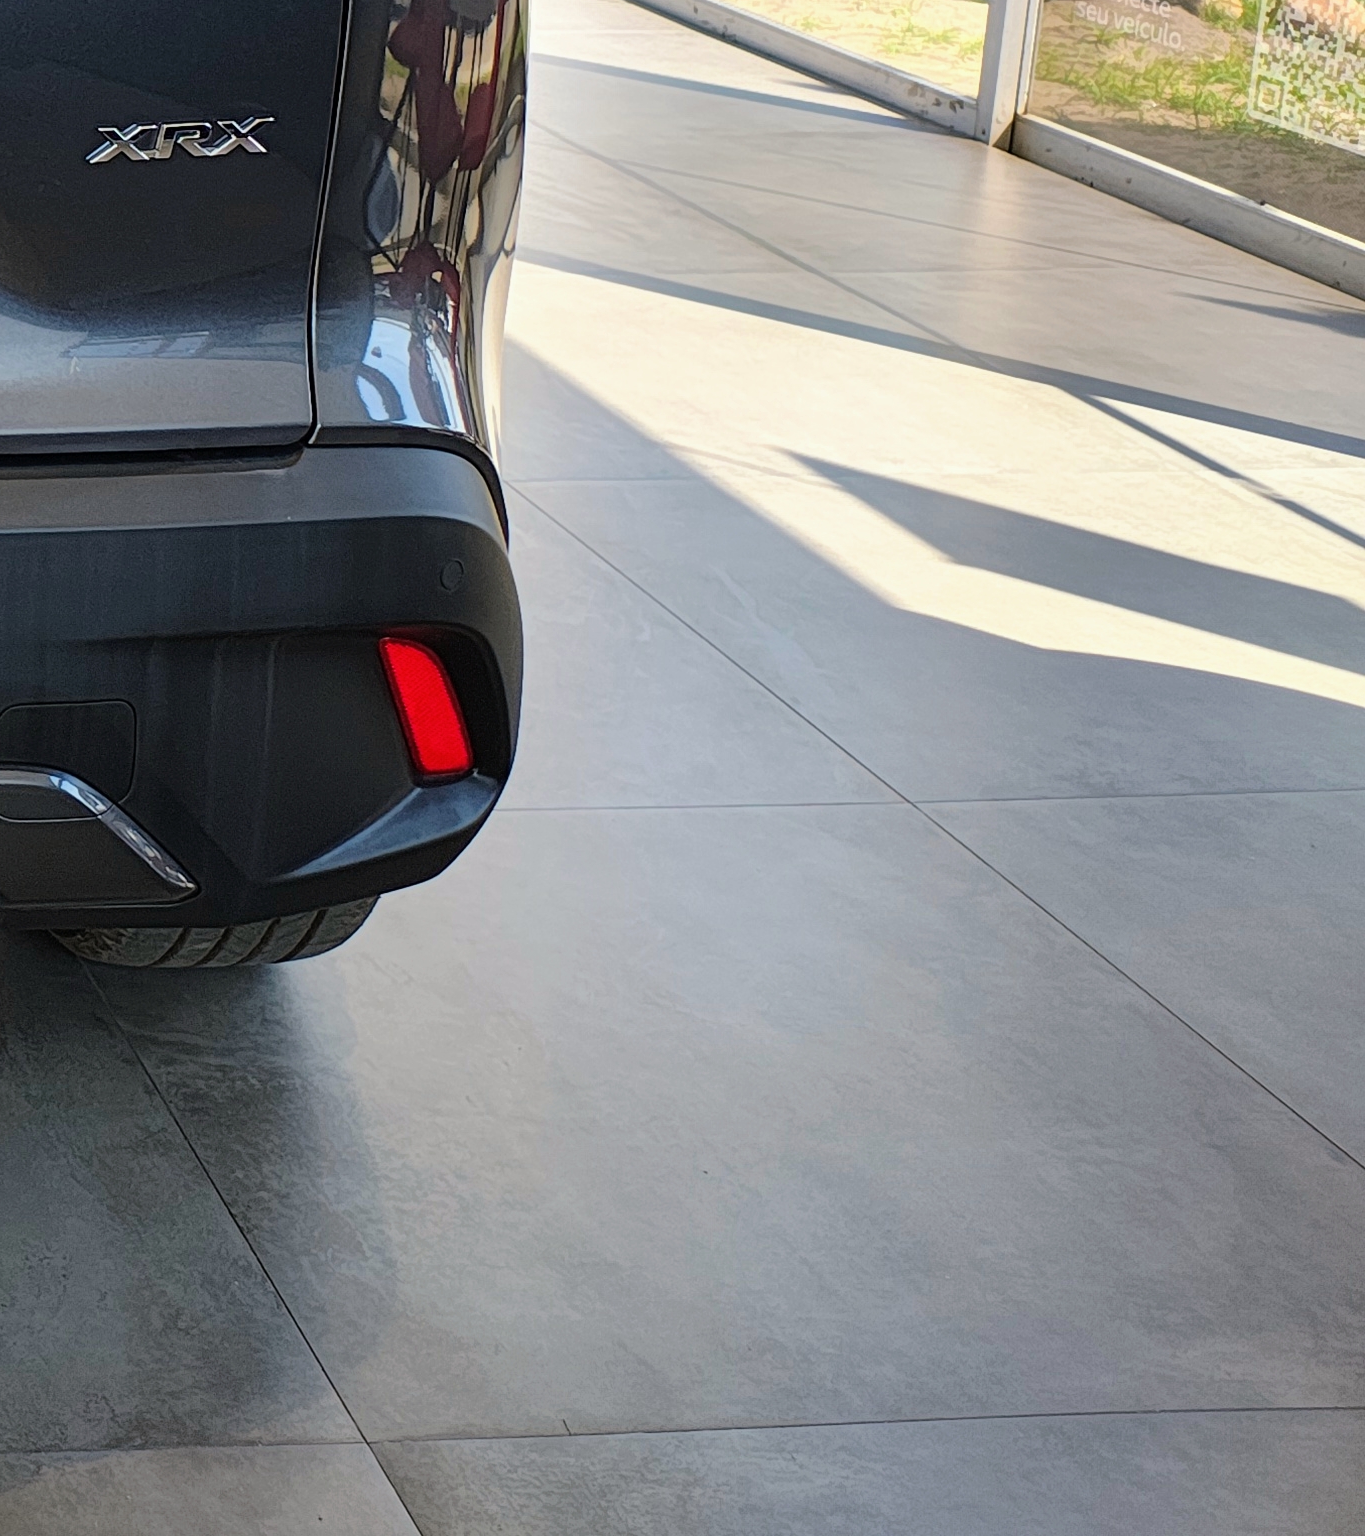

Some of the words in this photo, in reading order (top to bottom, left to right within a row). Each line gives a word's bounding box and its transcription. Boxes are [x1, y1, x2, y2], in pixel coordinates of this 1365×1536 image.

[1075, 0, 1109, 26] seu
[1113, 11, 1186, 52] veículo.
[84, 116, 276, 164] XRX
